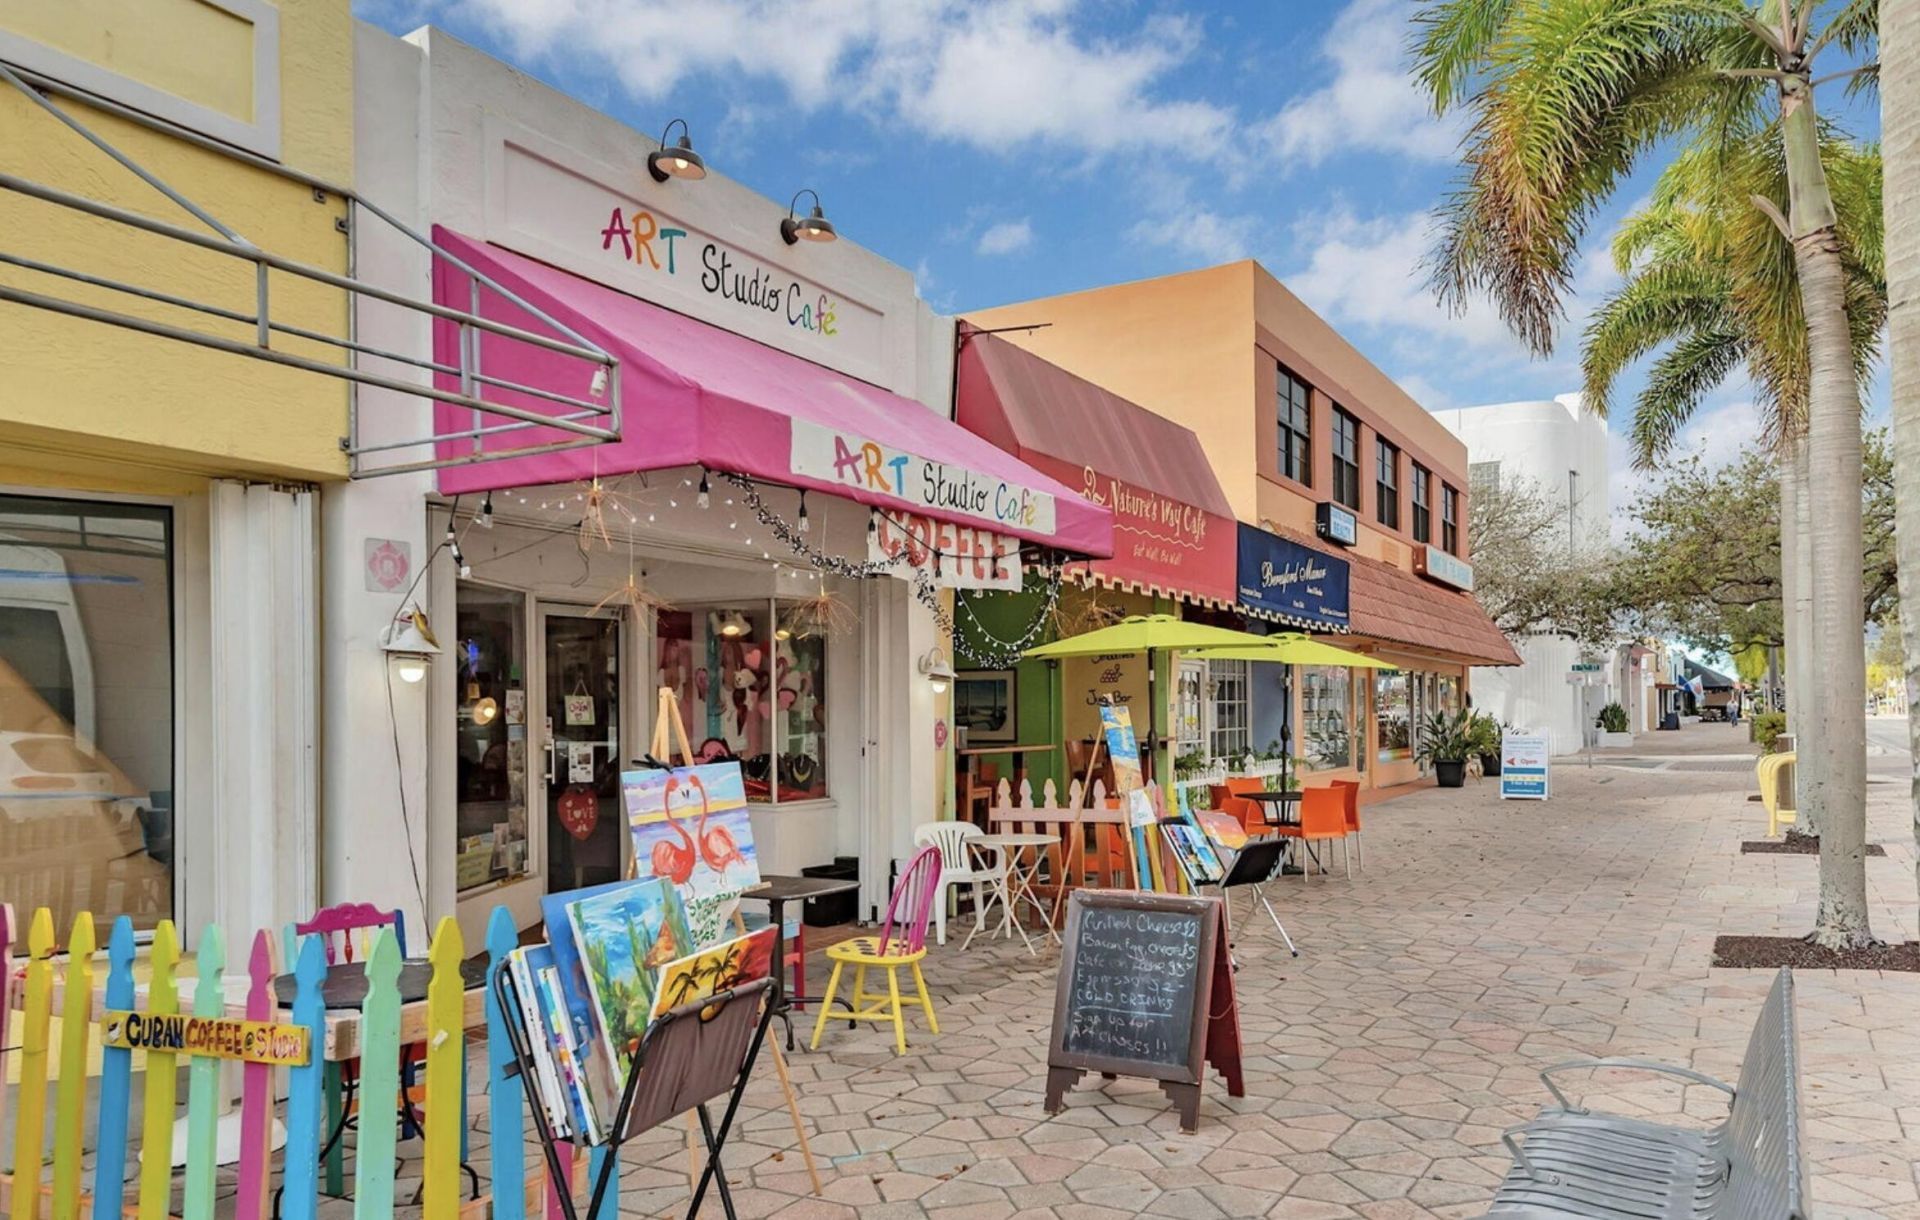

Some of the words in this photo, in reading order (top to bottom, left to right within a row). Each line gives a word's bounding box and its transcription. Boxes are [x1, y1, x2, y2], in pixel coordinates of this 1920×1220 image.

[601, 207, 687, 275] ART
[701, 244, 782, 313] Studio
[787, 282, 838, 336] Café
[833, 435, 909, 496] ART
[923, 462, 989, 512] Studio
[995, 483, 1037, 526] Café
[1110, 480, 1158, 521] Nature's
[1161, 500, 1182, 537] Way
[1184, 506, 1206, 543] Cafe
[878, 508, 1009, 580] COFFEE
[1300, 558, 1327, 582] Manor
[1082, 910, 1132, 931] Grilled
[1136, 914, 1181, 934] Cheese
[126, 1013, 184, 1049] CUBAN
[185, 1018, 242, 1055] COFFEE
